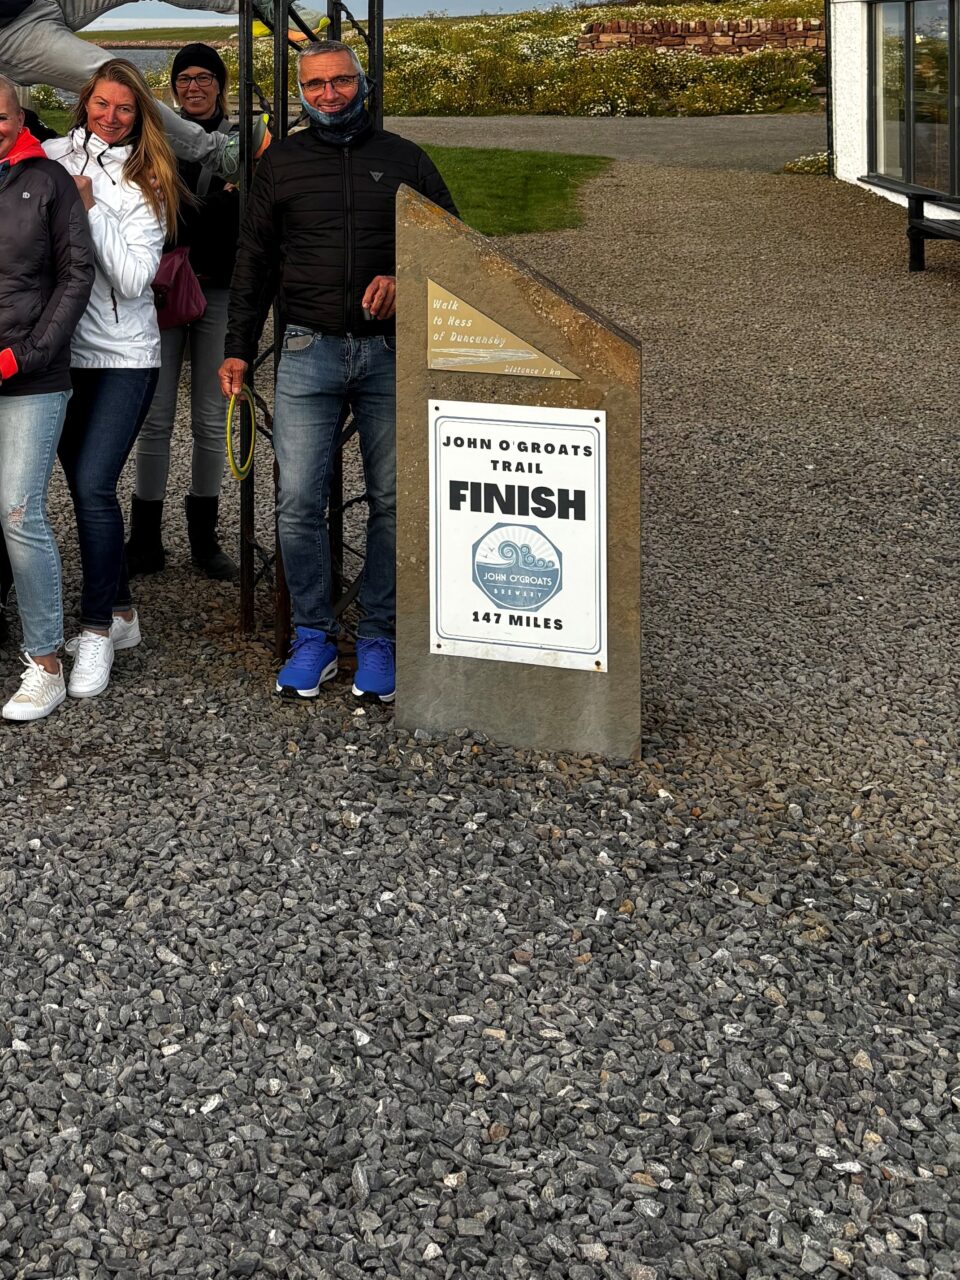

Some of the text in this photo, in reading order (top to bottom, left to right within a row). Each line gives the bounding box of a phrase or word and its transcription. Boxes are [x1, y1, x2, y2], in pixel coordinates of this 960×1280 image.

[432, 299, 459, 310] Walk
[432, 316, 473, 327] to Ness
[432, 331, 507, 347] of Duncansby
[504, 364, 539, 375] Distance
[549, 367, 561, 376] km
[442, 435, 593, 457] JOHN O'GROATS
[490, 459, 544, 474] TRAIL
[449, 479, 586, 521] FINISH
[483, 572, 507, 582] JOHN
[493, 587, 543, 599] BREWERY
[472, 611, 564, 631] 147 MILES
